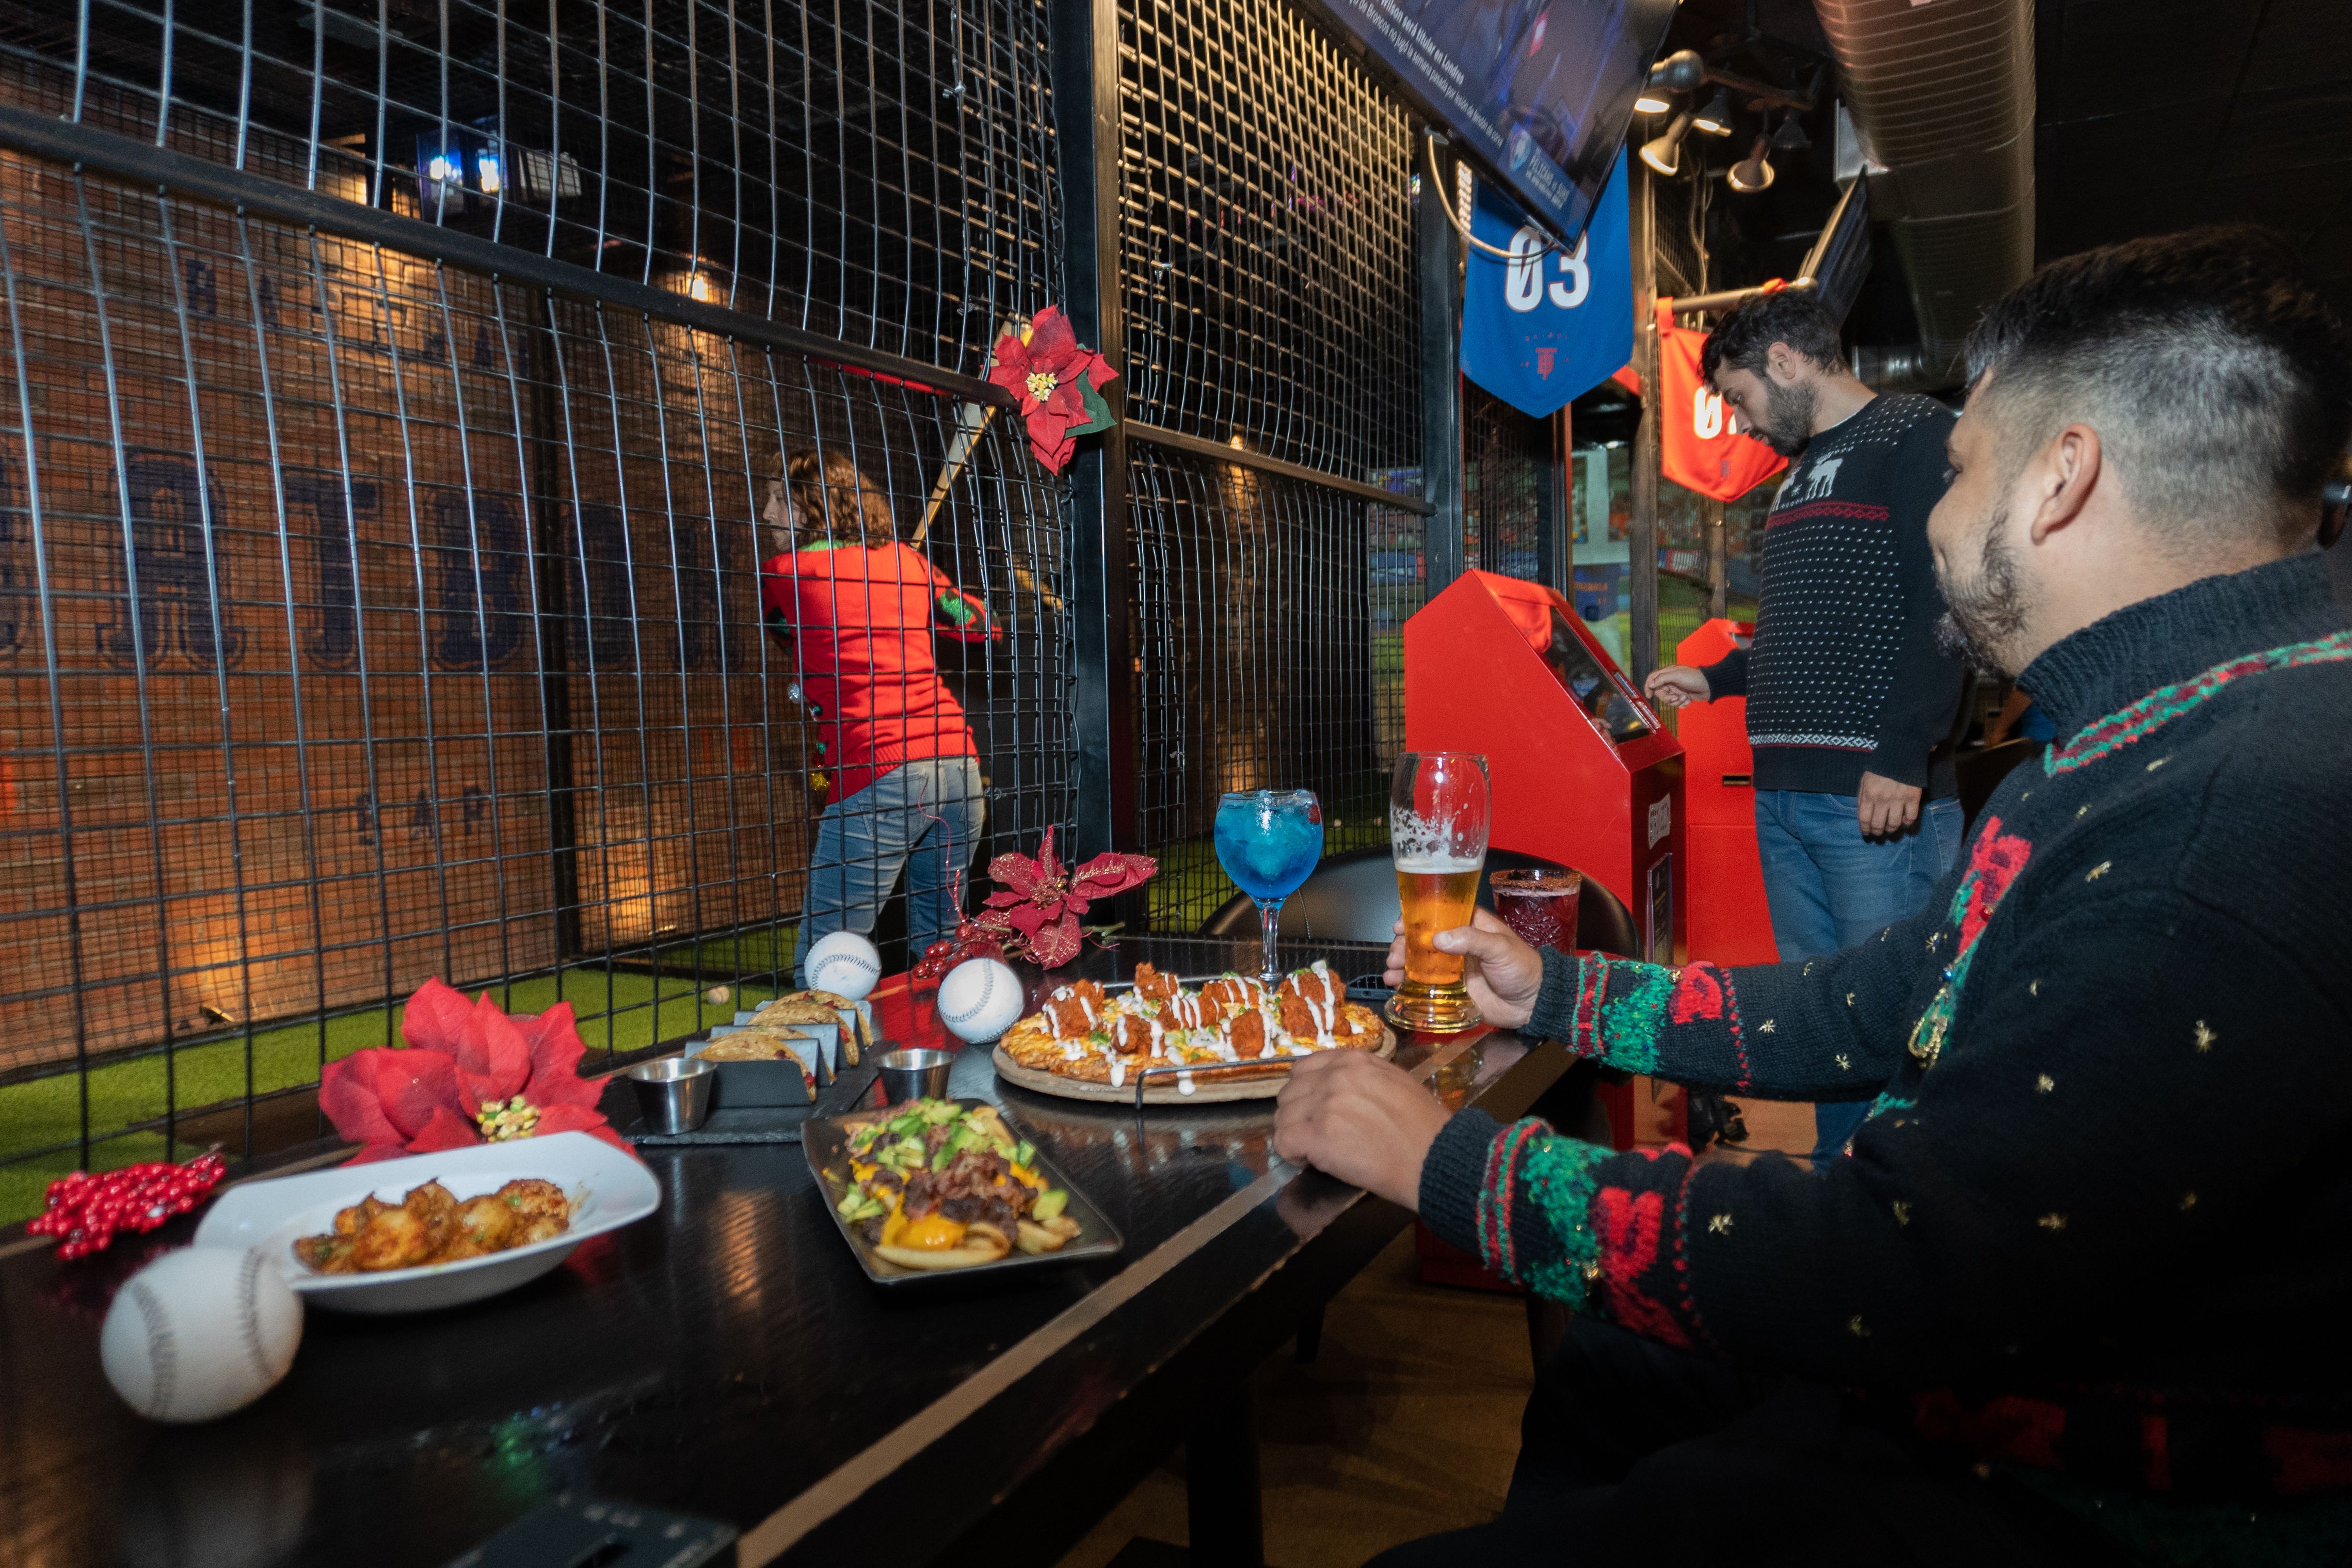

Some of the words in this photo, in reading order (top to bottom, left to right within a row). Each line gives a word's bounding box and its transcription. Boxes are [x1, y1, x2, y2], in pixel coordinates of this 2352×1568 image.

[1366, 3, 1390, 35] Broncos
[1388, 27, 1398, 41] no
[1412, 51, 1432, 76] semana
[1416, 27, 1436, 56] titular
[1434, 49, 1444, 64] en
[1442, 54, 1465, 86] Londres
[1505, 226, 1591, 313] 03
[1693, 386, 1737, 440] 0
